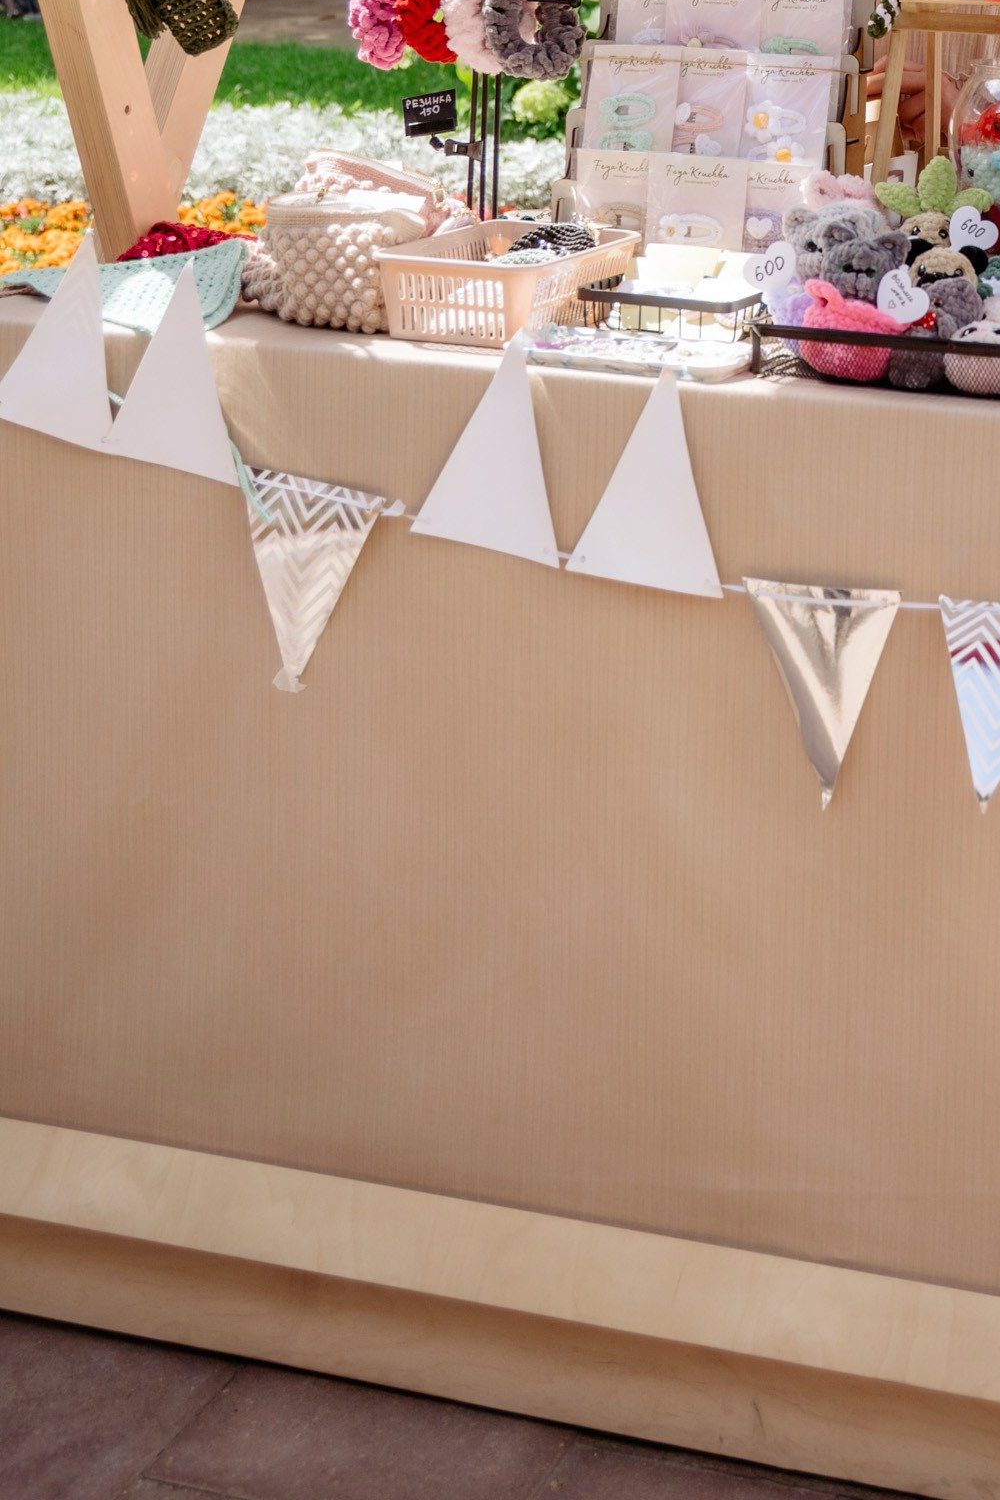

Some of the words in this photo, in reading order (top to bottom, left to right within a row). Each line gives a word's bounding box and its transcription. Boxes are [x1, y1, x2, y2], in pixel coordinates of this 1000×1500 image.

[405, 93, 452, 110] РЕЗИНКА
[419, 104, 441, 117] 150
[960, 218, 986, 238] 600
[755, 255, 785, 282] 600
